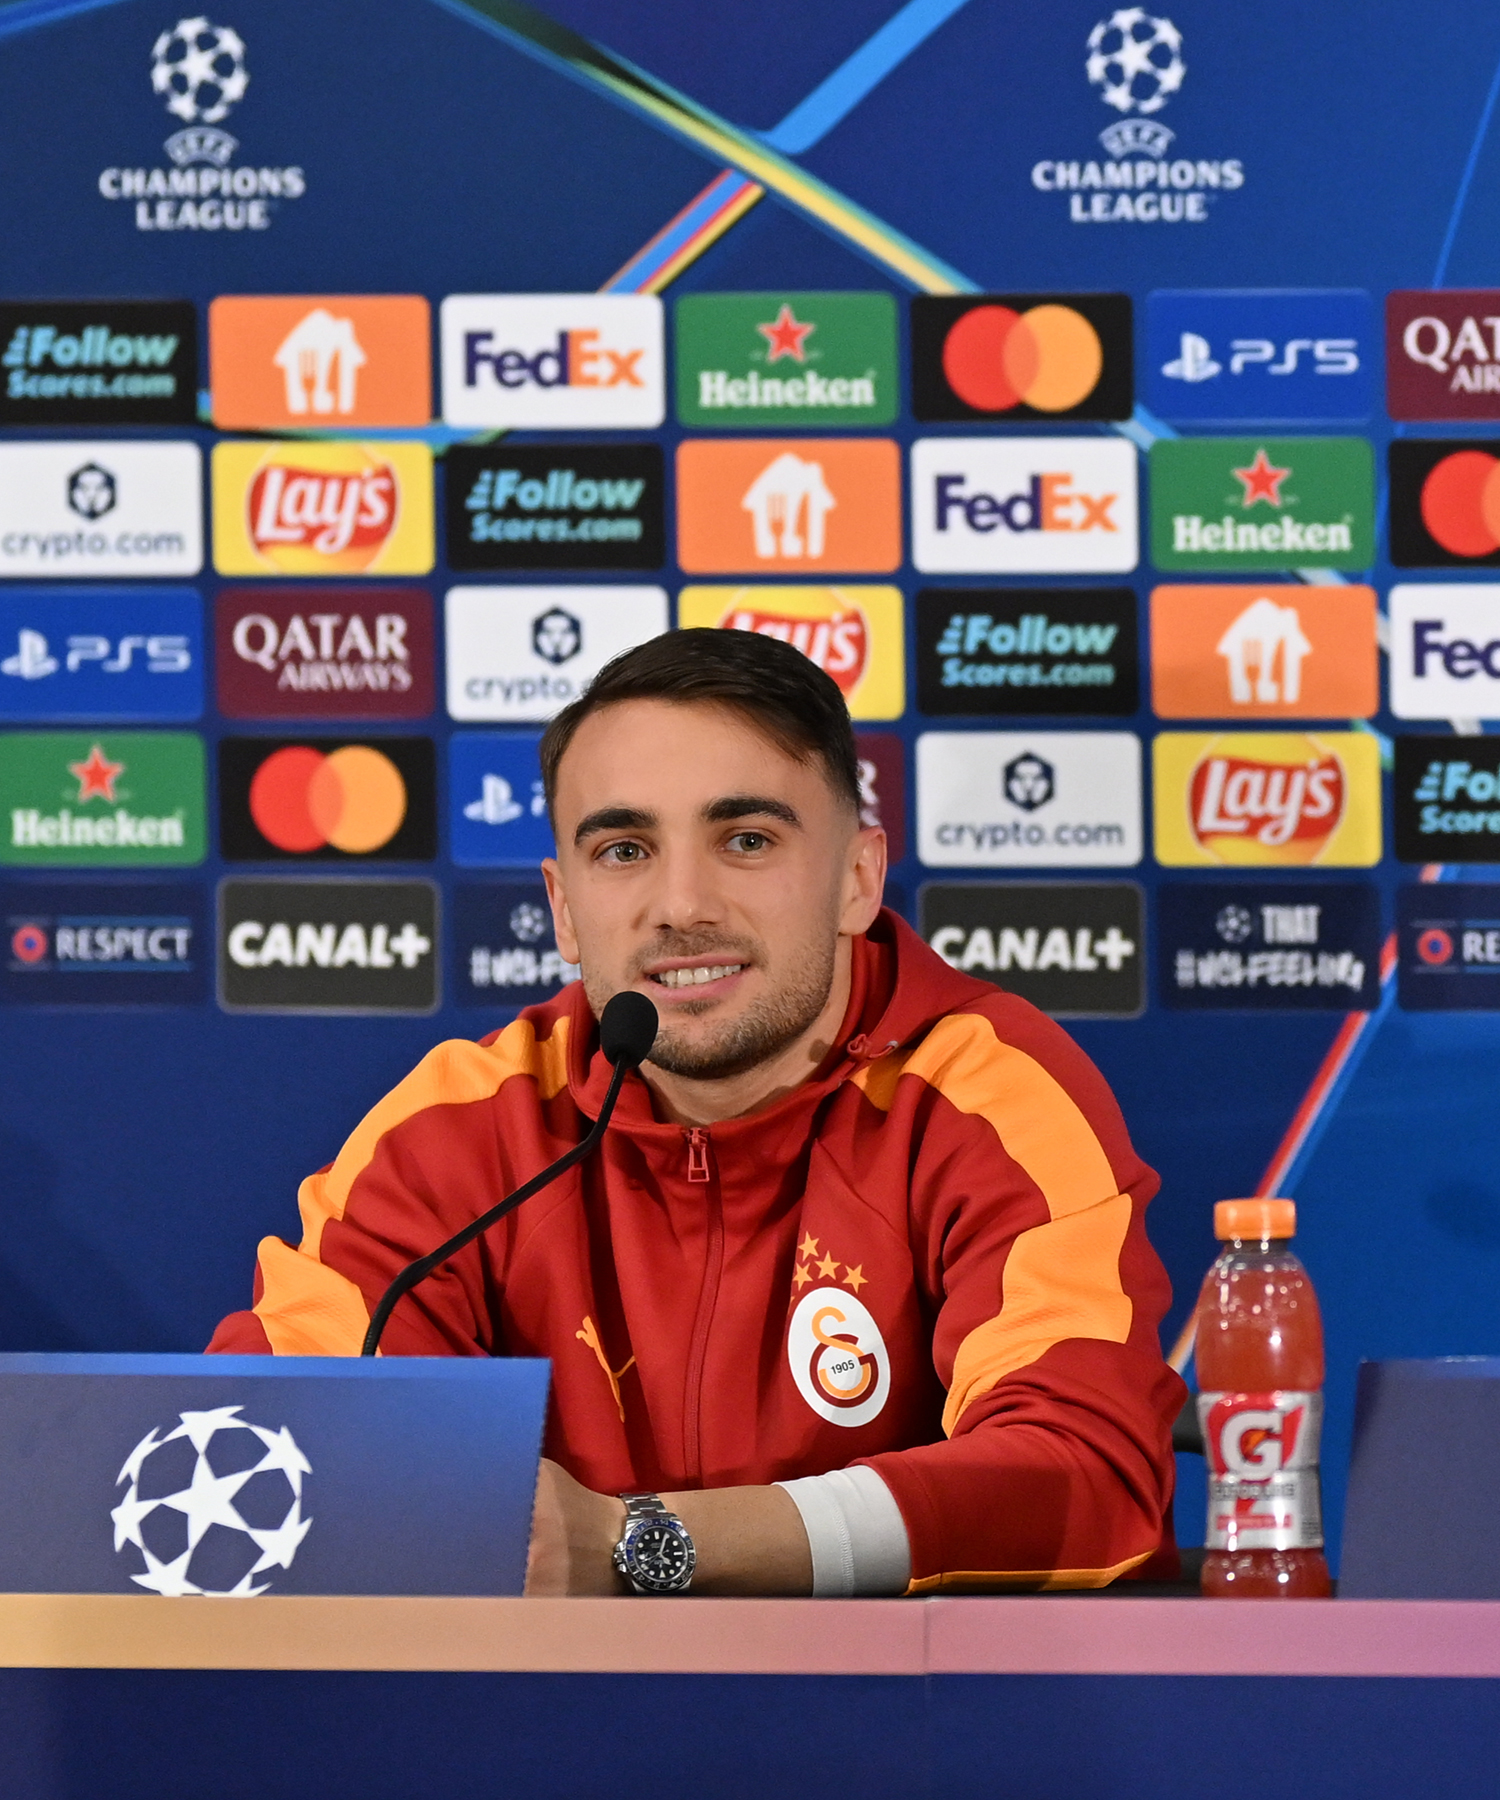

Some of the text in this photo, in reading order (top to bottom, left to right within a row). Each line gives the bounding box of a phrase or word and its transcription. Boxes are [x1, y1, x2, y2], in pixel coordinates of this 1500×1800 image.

[99, 167, 305, 198] CHAMPIONS
[1032, 160, 1244, 190] CHAMPIONS
[136, 200, 267, 229] LEAGUE
[1071, 193, 1206, 222] LEAGUE
[29, 325, 177, 367] Follow
[464, 330, 644, 389] FedEx
[1230, 339, 1359, 374] PS5
[8, 369, 177, 398] Scores.com
[699, 371, 875, 407] Heineken
[492, 470, 643, 508] Follow
[934, 474, 1118, 534] FedEx
[256, 466, 392, 552] Lay's
[471, 512, 642, 541] Scores.com
[1, 530, 185, 558] crypto.com
[1173, 516, 1352, 552] Heineken
[232, 613, 408, 668] QATAR
[964, 615, 1118, 652] Follow
[67, 636, 191, 672] PS5
[942, 657, 1114, 686] Scores.com
[279, 661, 411, 691] AIRWAYS
[465, 674, 582, 700] crypto.
[1198, 760, 1340, 846] Lay's
[12, 809, 184, 846] Heineken
[935, 820, 1125, 850] crypto.com
[57, 928, 190, 961] RESPECT
[228, 922, 430, 967] CANAL+
[931, 926, 1134, 970] CANAL+
[831, 1360, 855, 1375] 1905
